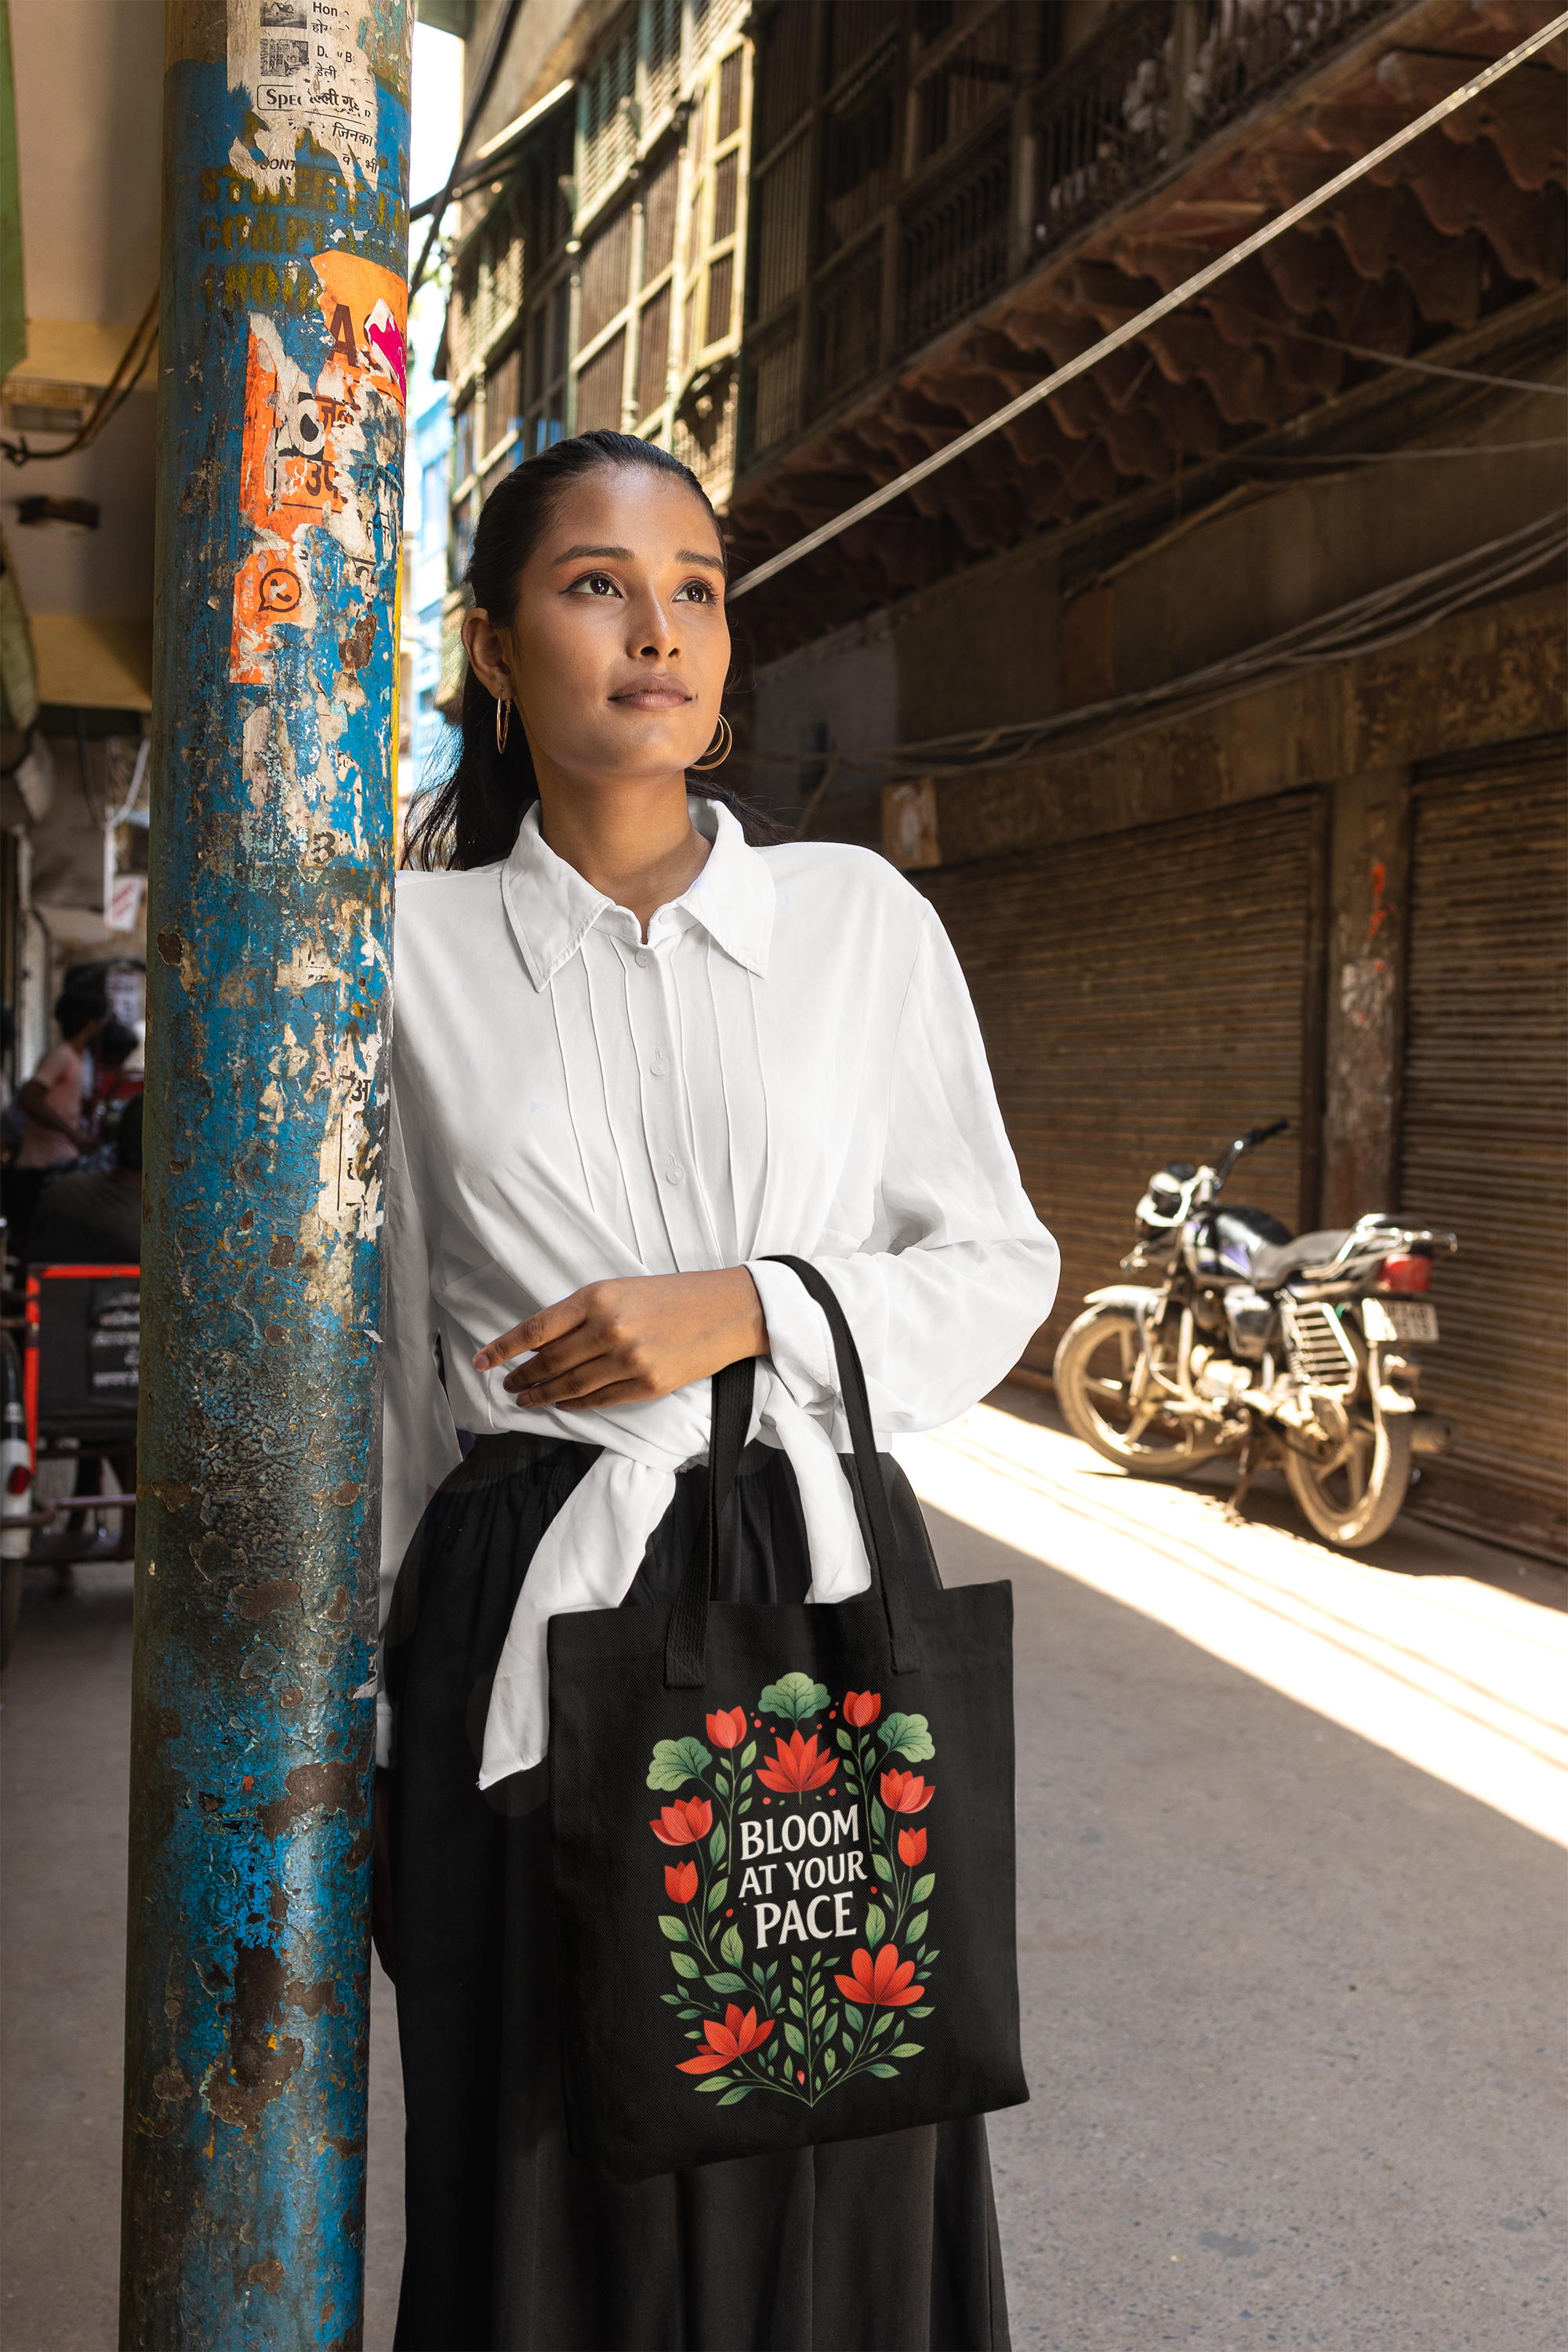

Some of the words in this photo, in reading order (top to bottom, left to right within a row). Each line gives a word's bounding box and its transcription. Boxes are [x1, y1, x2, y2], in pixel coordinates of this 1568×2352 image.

[332, 122, 374, 147] जिनका
[739, 1804, 859, 1860] BLOOM
[738, 1864, 778, 1898] AT
[784, 1850, 868, 1891] YOUR
[753, 1890, 857, 1949] PACE
